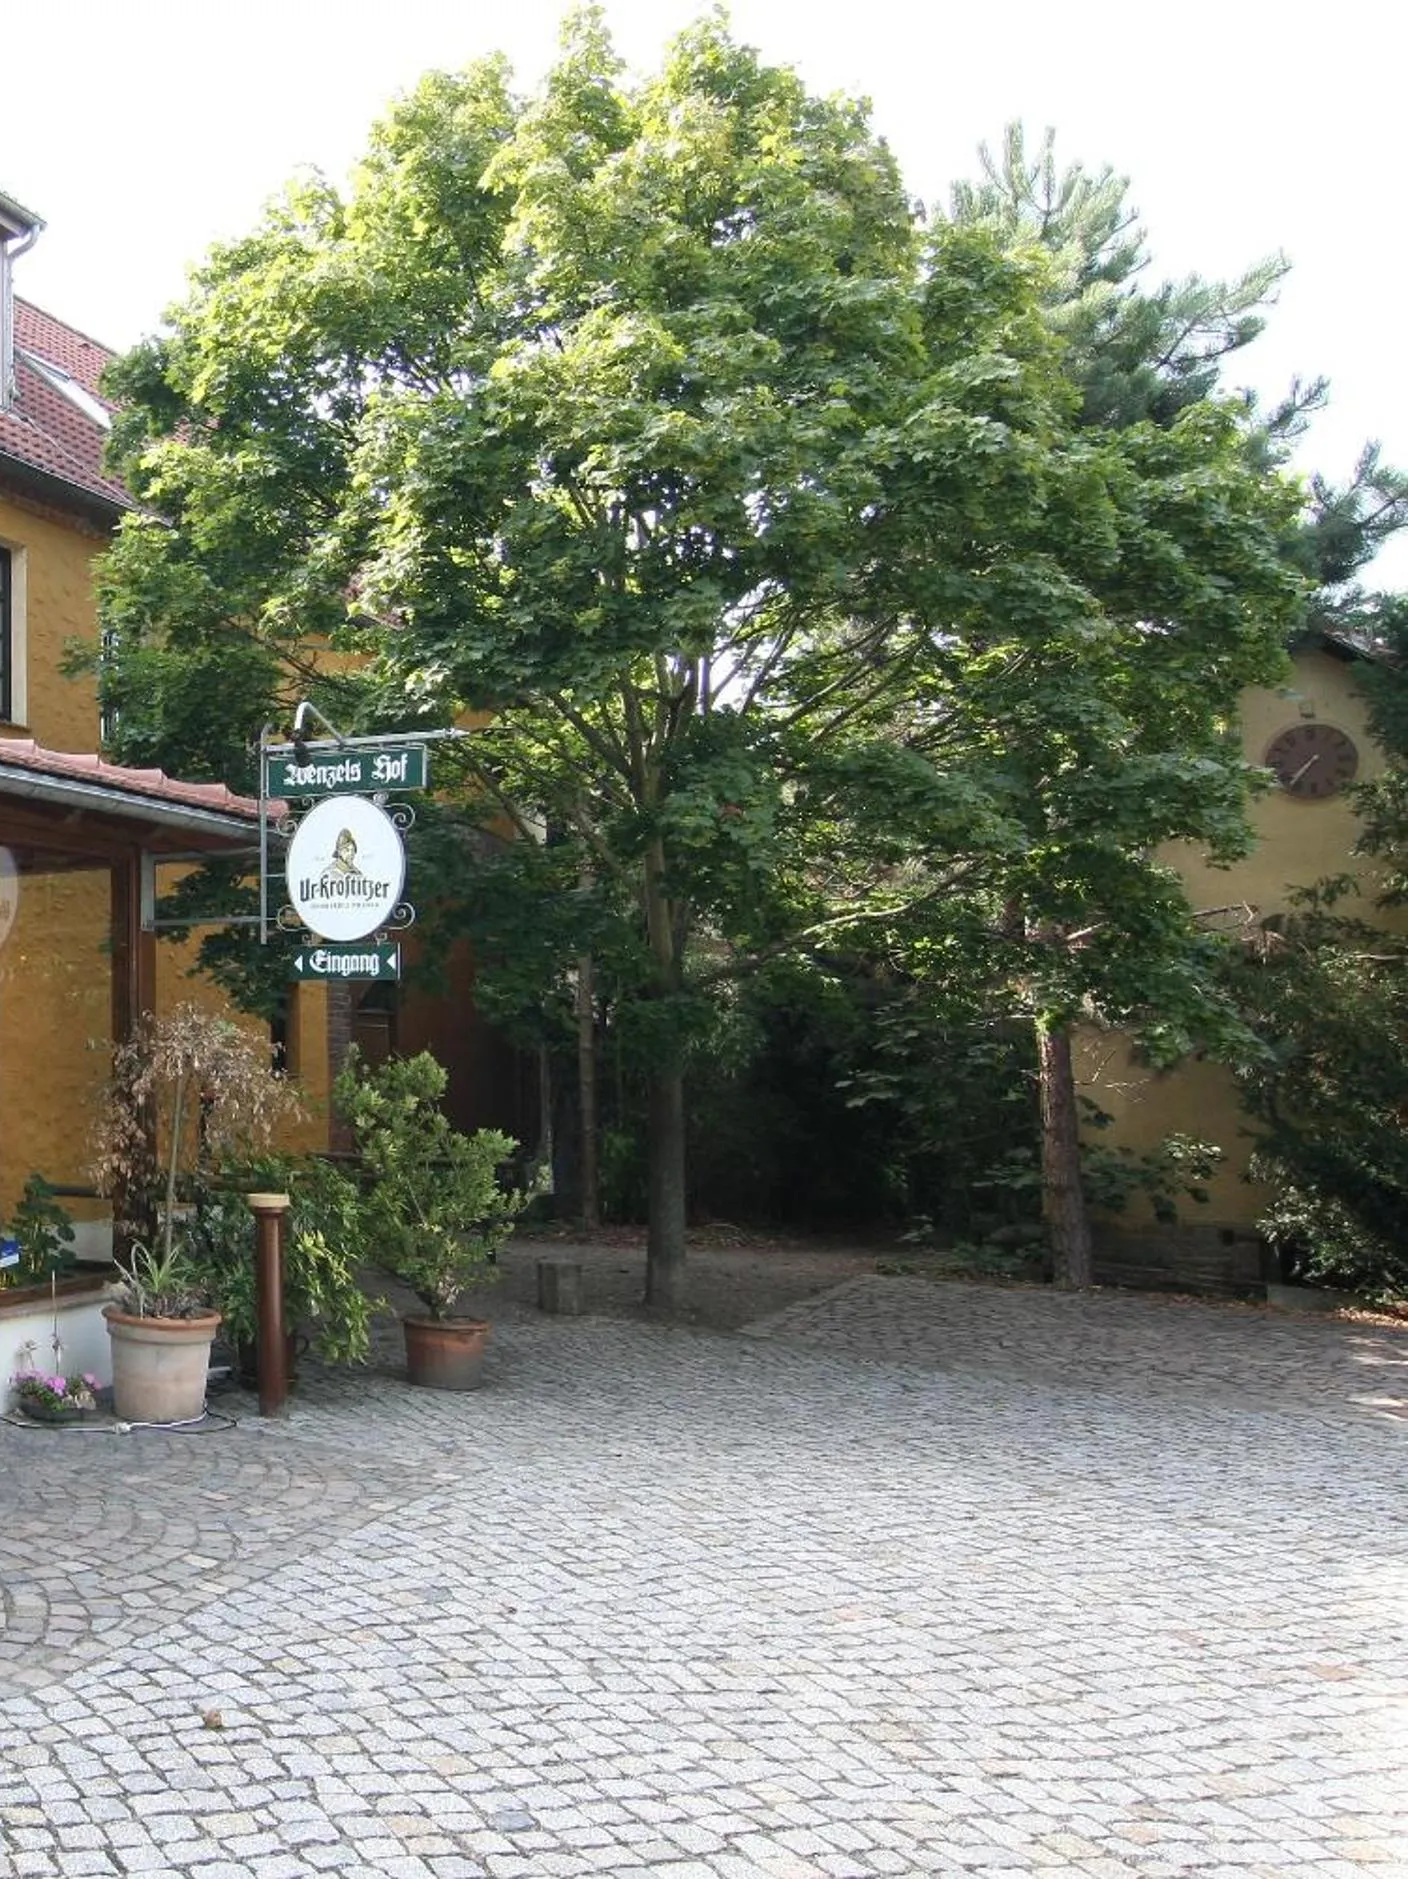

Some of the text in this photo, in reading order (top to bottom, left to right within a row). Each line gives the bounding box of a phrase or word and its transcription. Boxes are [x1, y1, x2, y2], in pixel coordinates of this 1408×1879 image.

[283, 753, 408, 789] Wenzels Hof
[309, 950, 380, 976] Eingang
